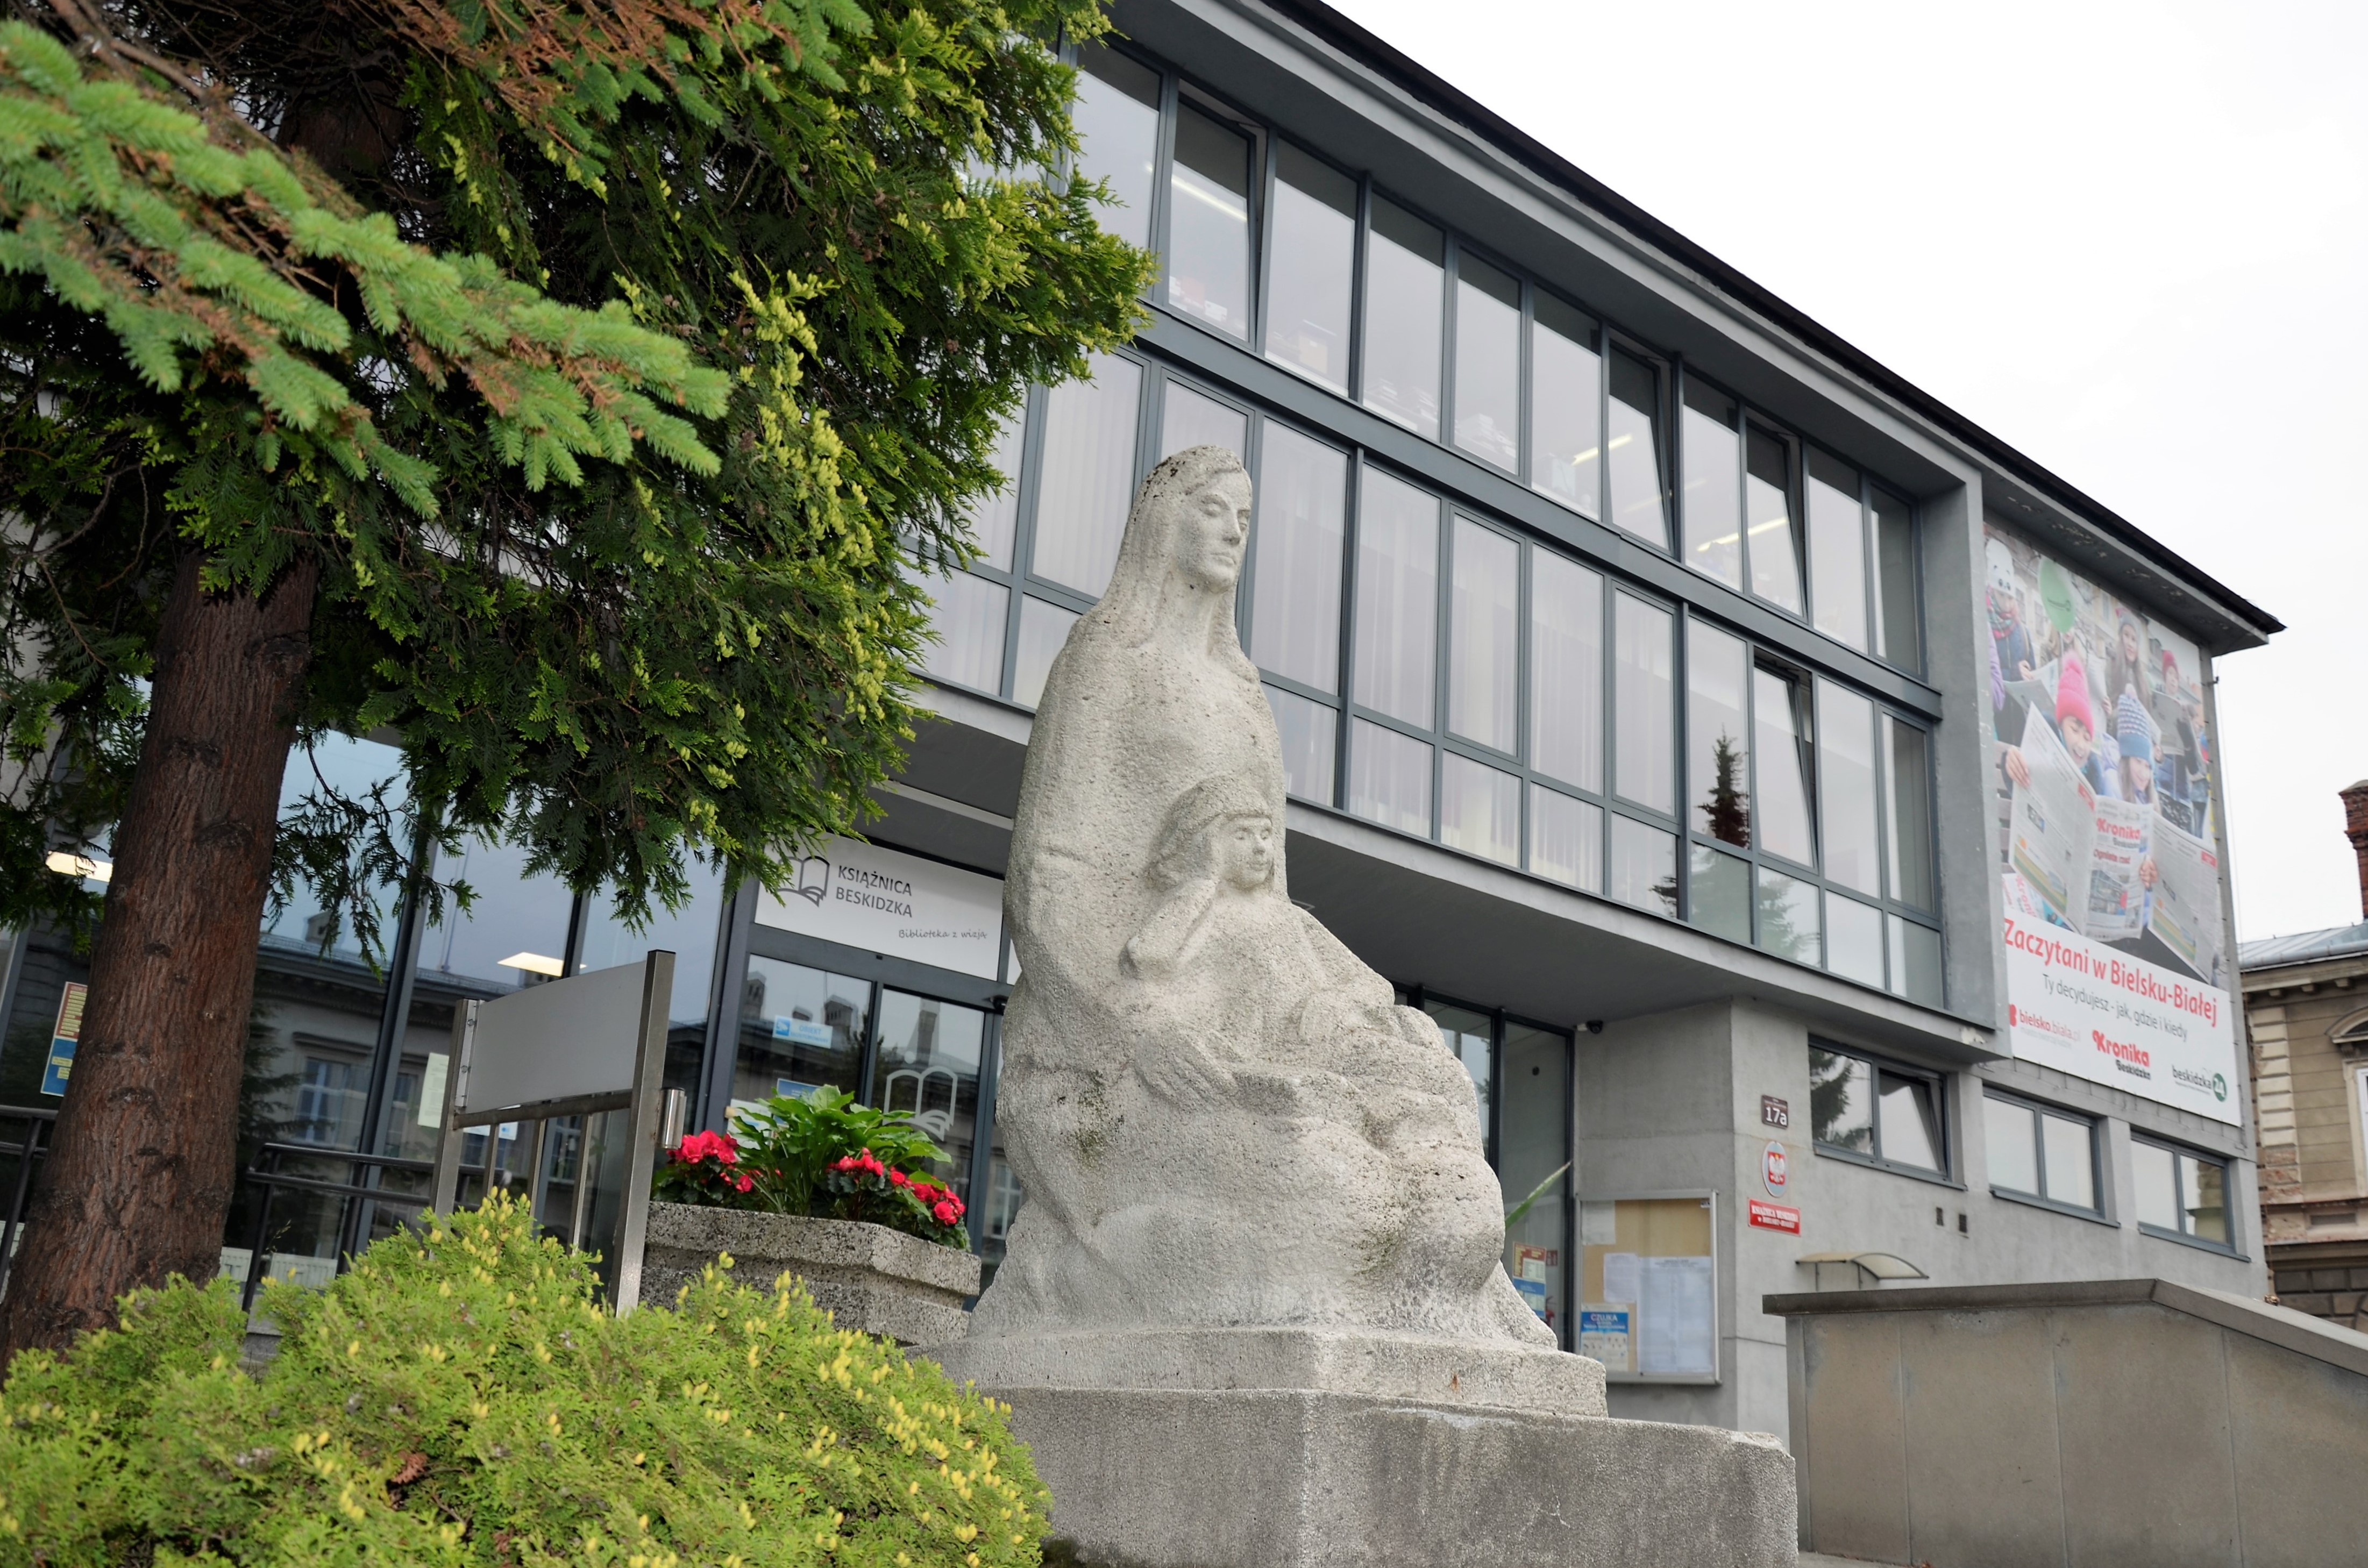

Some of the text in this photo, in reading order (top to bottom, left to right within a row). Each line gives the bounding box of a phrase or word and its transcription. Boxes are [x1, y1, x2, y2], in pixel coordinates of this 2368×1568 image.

[838, 865, 912, 896] KSIĄŻNICA
[836, 887, 912, 918] BESKIDZKA
[899, 929, 950, 938] Biblioteka
[961, 929, 987, 940] wizją
[2004, 917, 2216, 1028] Zaczytani w Bielsku-Białej
[2043, 973, 2054, 995] Ty
[2056, 979, 2110, 1011] decydujesz
[2134, 1009, 2158, 1029] gdzie
[2163, 1017, 2188, 1042] kiedy
[2093, 1030, 2150, 1067] Kronika
[2172, 1064, 2211, 1089] beskidzka
[1766, 1106, 1788, 1126] 17a
